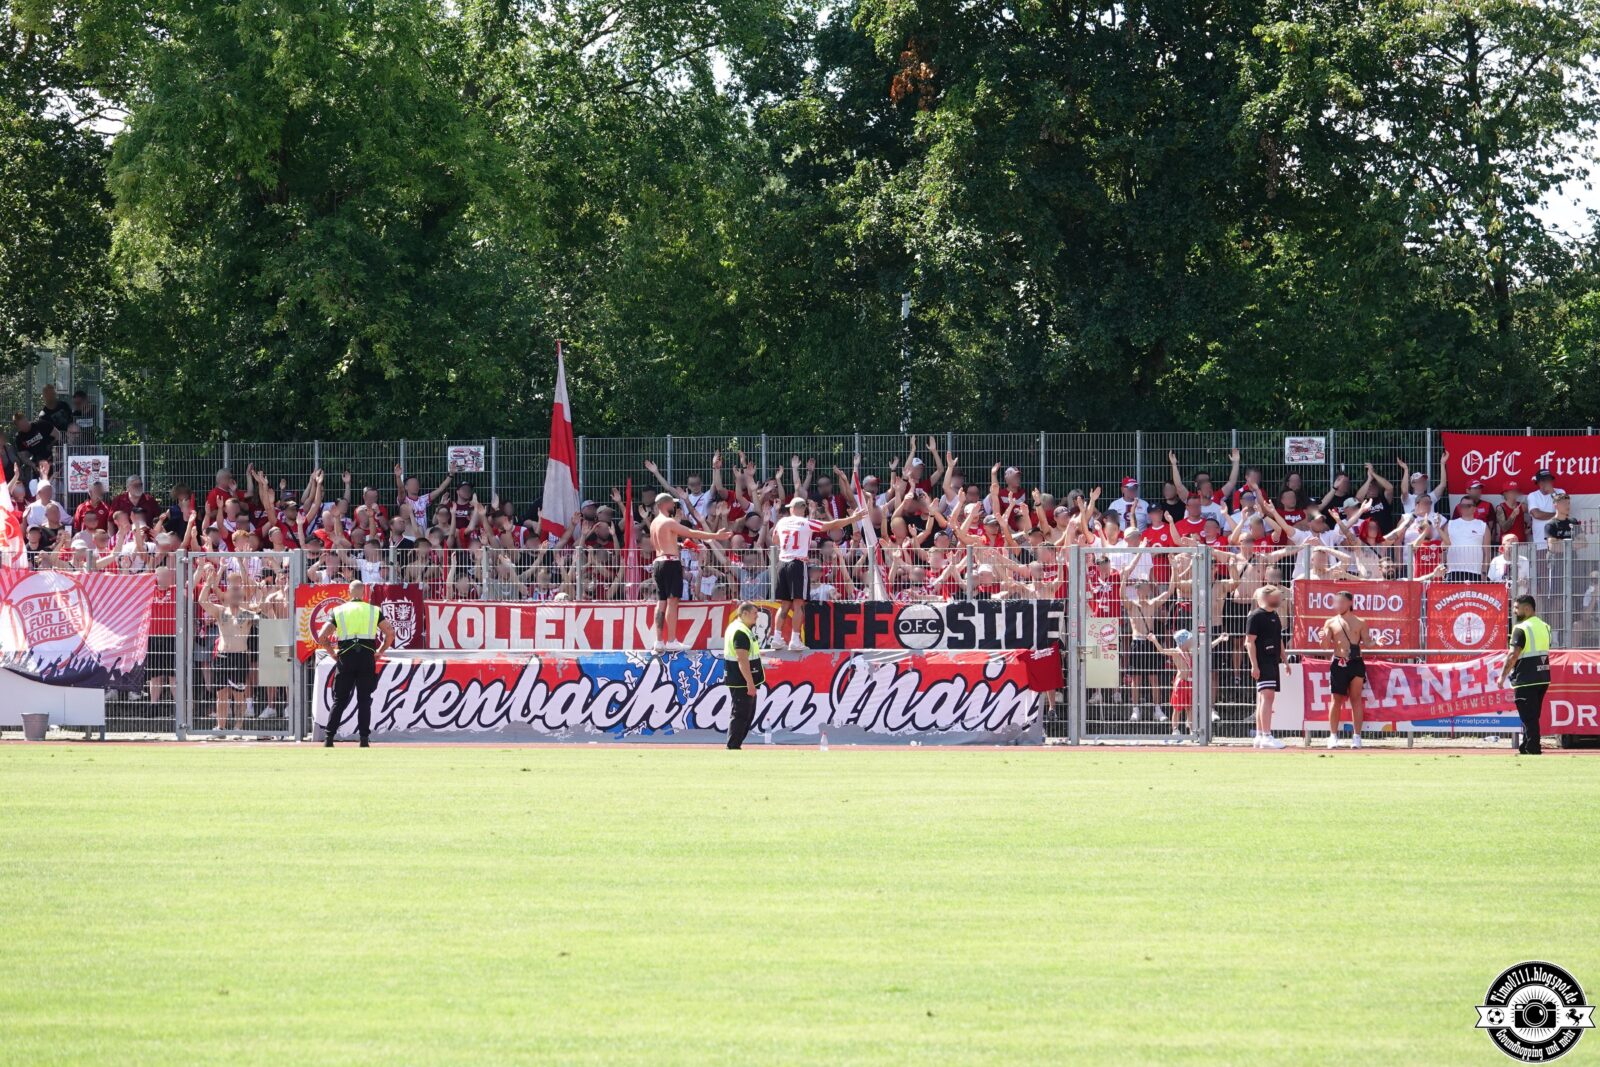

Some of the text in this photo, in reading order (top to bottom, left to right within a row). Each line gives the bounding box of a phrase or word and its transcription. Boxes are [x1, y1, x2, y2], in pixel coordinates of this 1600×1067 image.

[1461, 449, 1522, 480] OFC
[782, 530, 800, 550] 71
[38, 594, 71, 610] WIR
[1308, 592, 1404, 612] HORIDO
[28, 605, 83, 630] FÜR DIE
[428, 604, 726, 650] KOLLEKTIV 71
[804, 600, 1064, 650] OFF SIDE
[898, 618, 942, 634] O.F.C.
[26, 618, 84, 645] KICKERS
[691, 682, 818, 733] am
[828, 655, 1041, 732] Main
